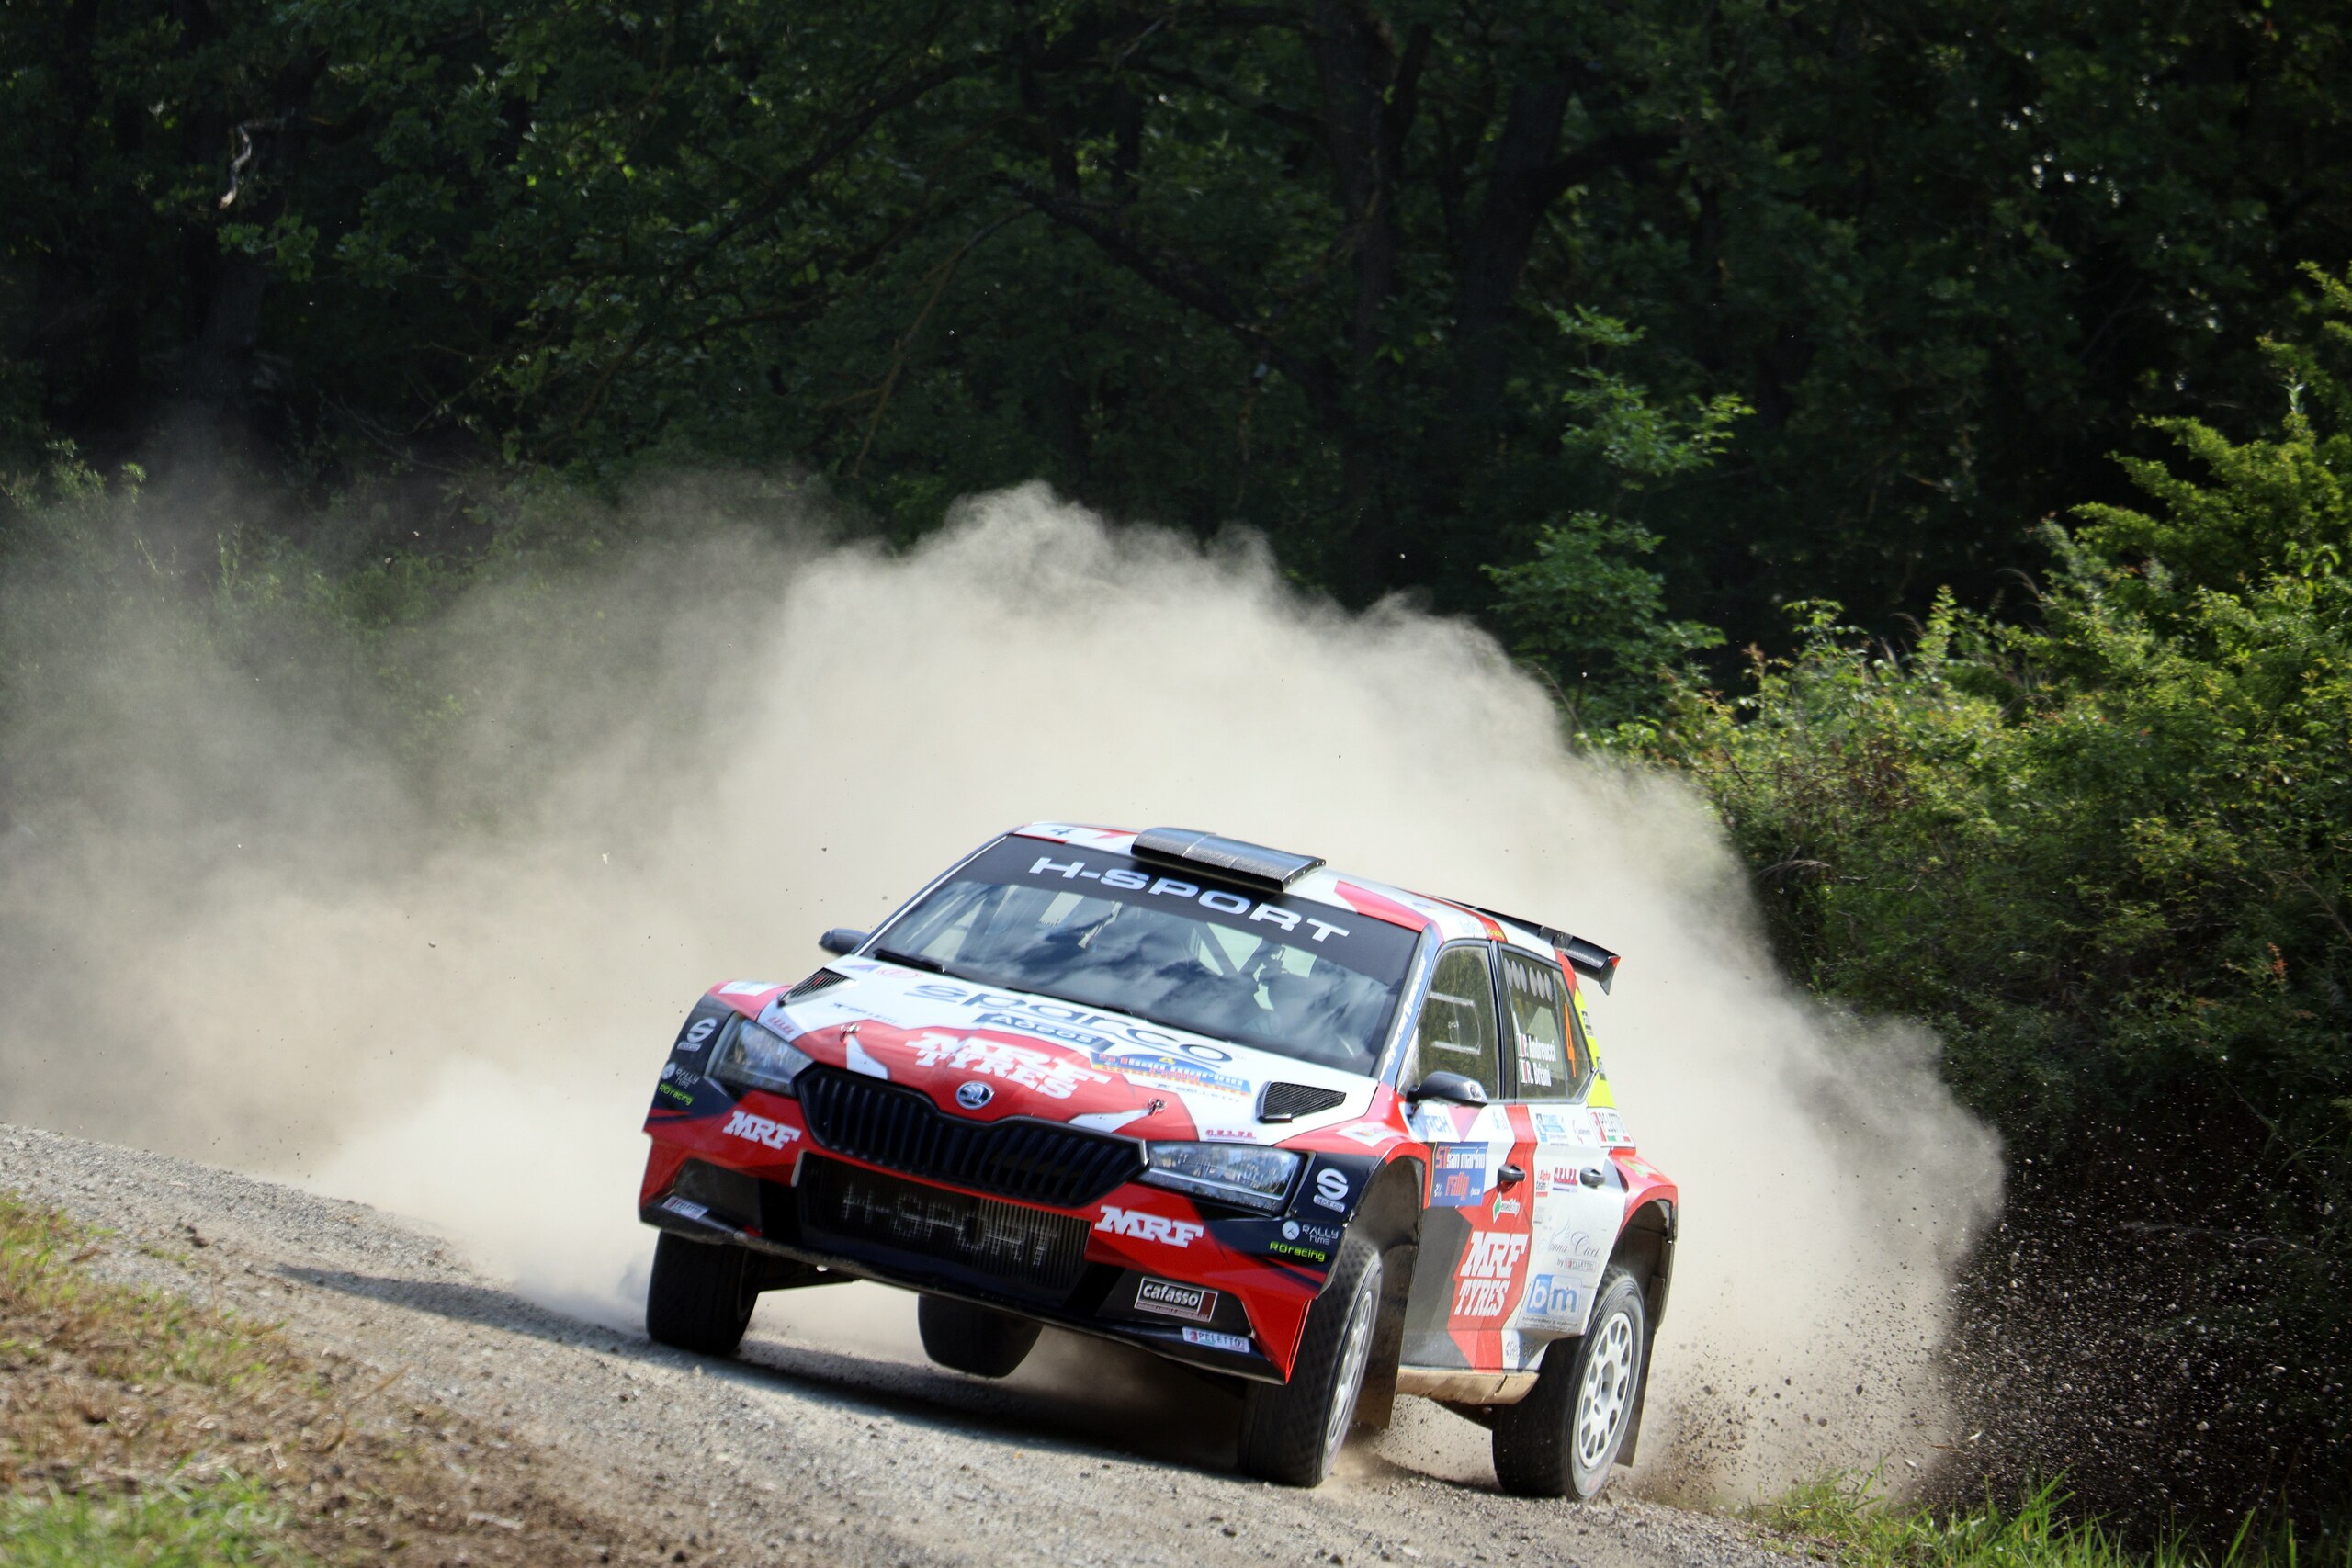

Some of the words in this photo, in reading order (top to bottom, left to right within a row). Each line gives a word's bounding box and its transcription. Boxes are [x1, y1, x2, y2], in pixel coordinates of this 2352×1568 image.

[1028, 856, 1350, 942] H-SPORT
[903, 984, 1233, 1064] sparco
[904, 1032, 1112, 1085] MRF
[915, 1050, 1079, 1099] TYRES
[722, 1111, 802, 1150] MRF
[1445, 1171, 1469, 1201] rally
[1094, 1205, 1204, 1248] MRF
[1302, 1224, 1340, 1239] RALLY
[1460, 1232, 1528, 1279] MRF
[1453, 1280, 1510, 1317] TYRES
[1530, 1279, 1577, 1313] bm
